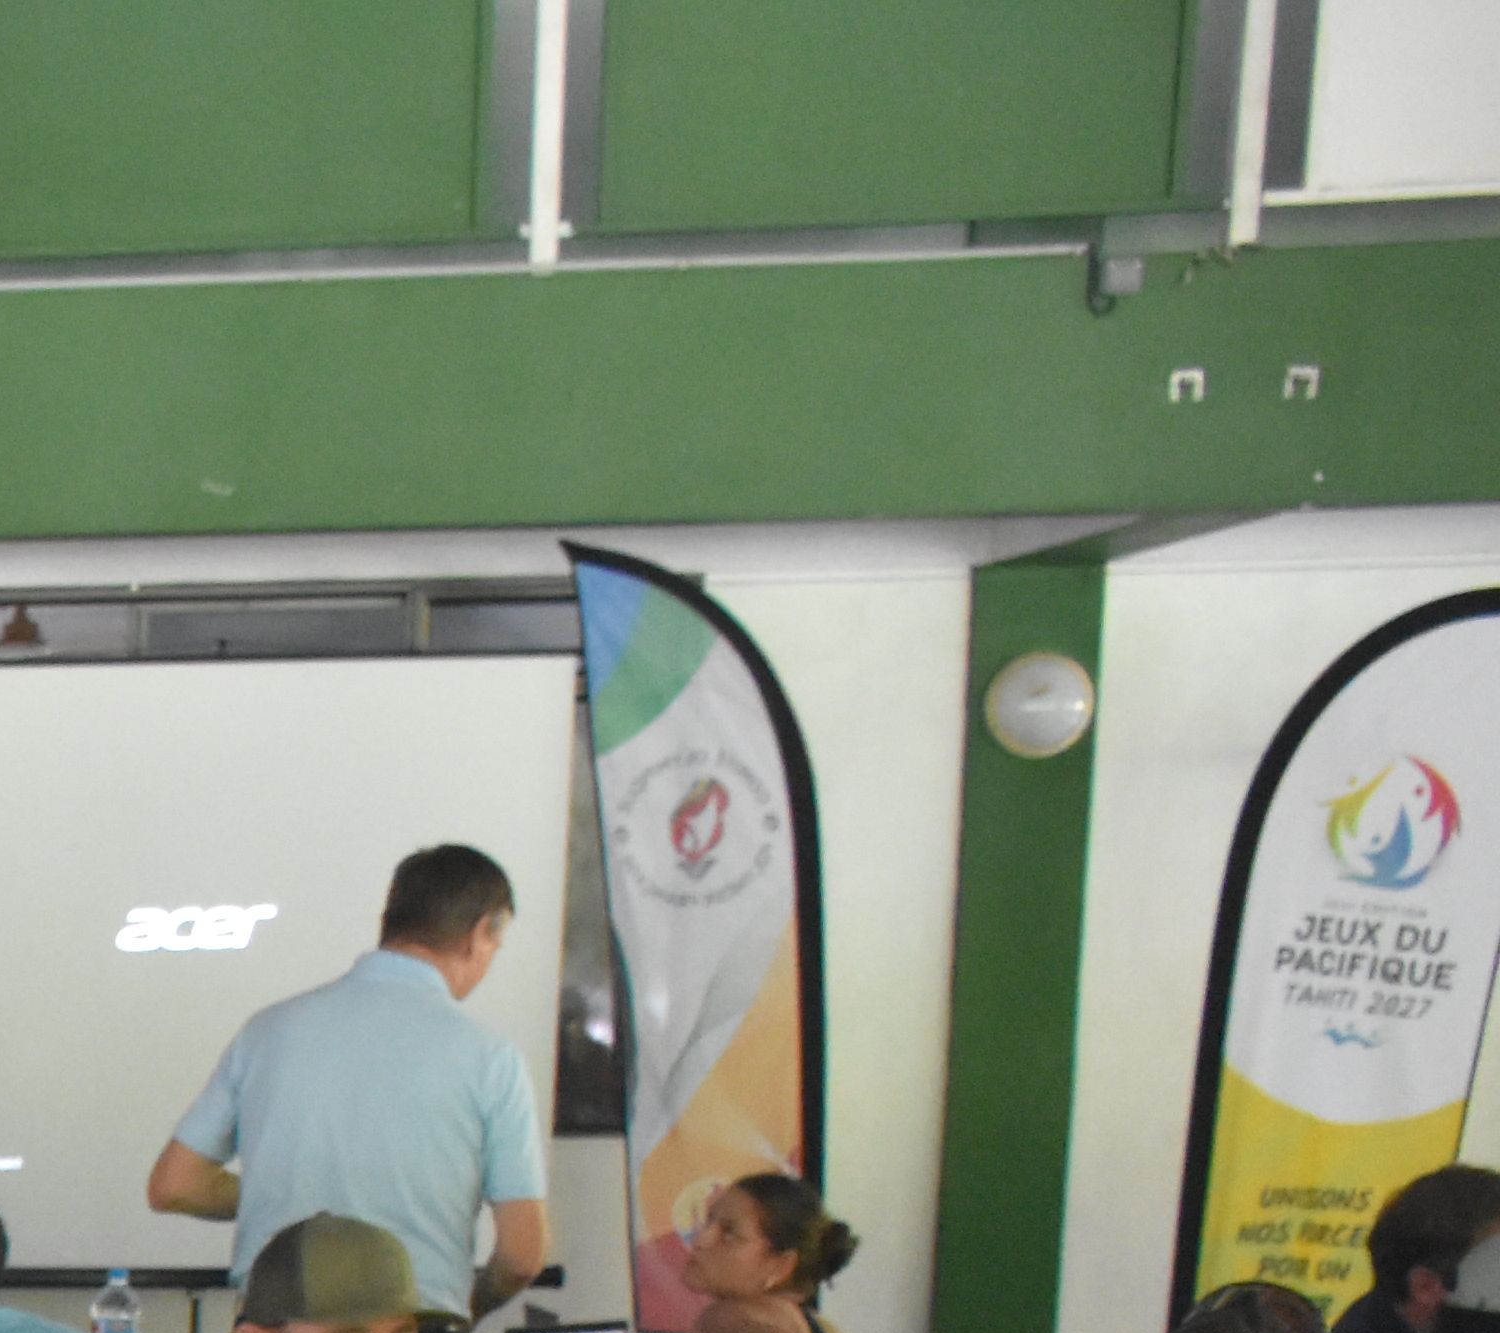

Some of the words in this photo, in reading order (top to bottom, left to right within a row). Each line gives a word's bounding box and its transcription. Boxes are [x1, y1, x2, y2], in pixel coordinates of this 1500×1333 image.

[115, 903, 278, 953] acer
[1294, 914, 1382, 947] JEUX
[1395, 925, 1448, 956] DU
[1274, 946, 1457, 992] PACIFIQUE
[1283, 982, 1359, 1011] TAHITI
[1364, 989, 1433, 1020] 2027
